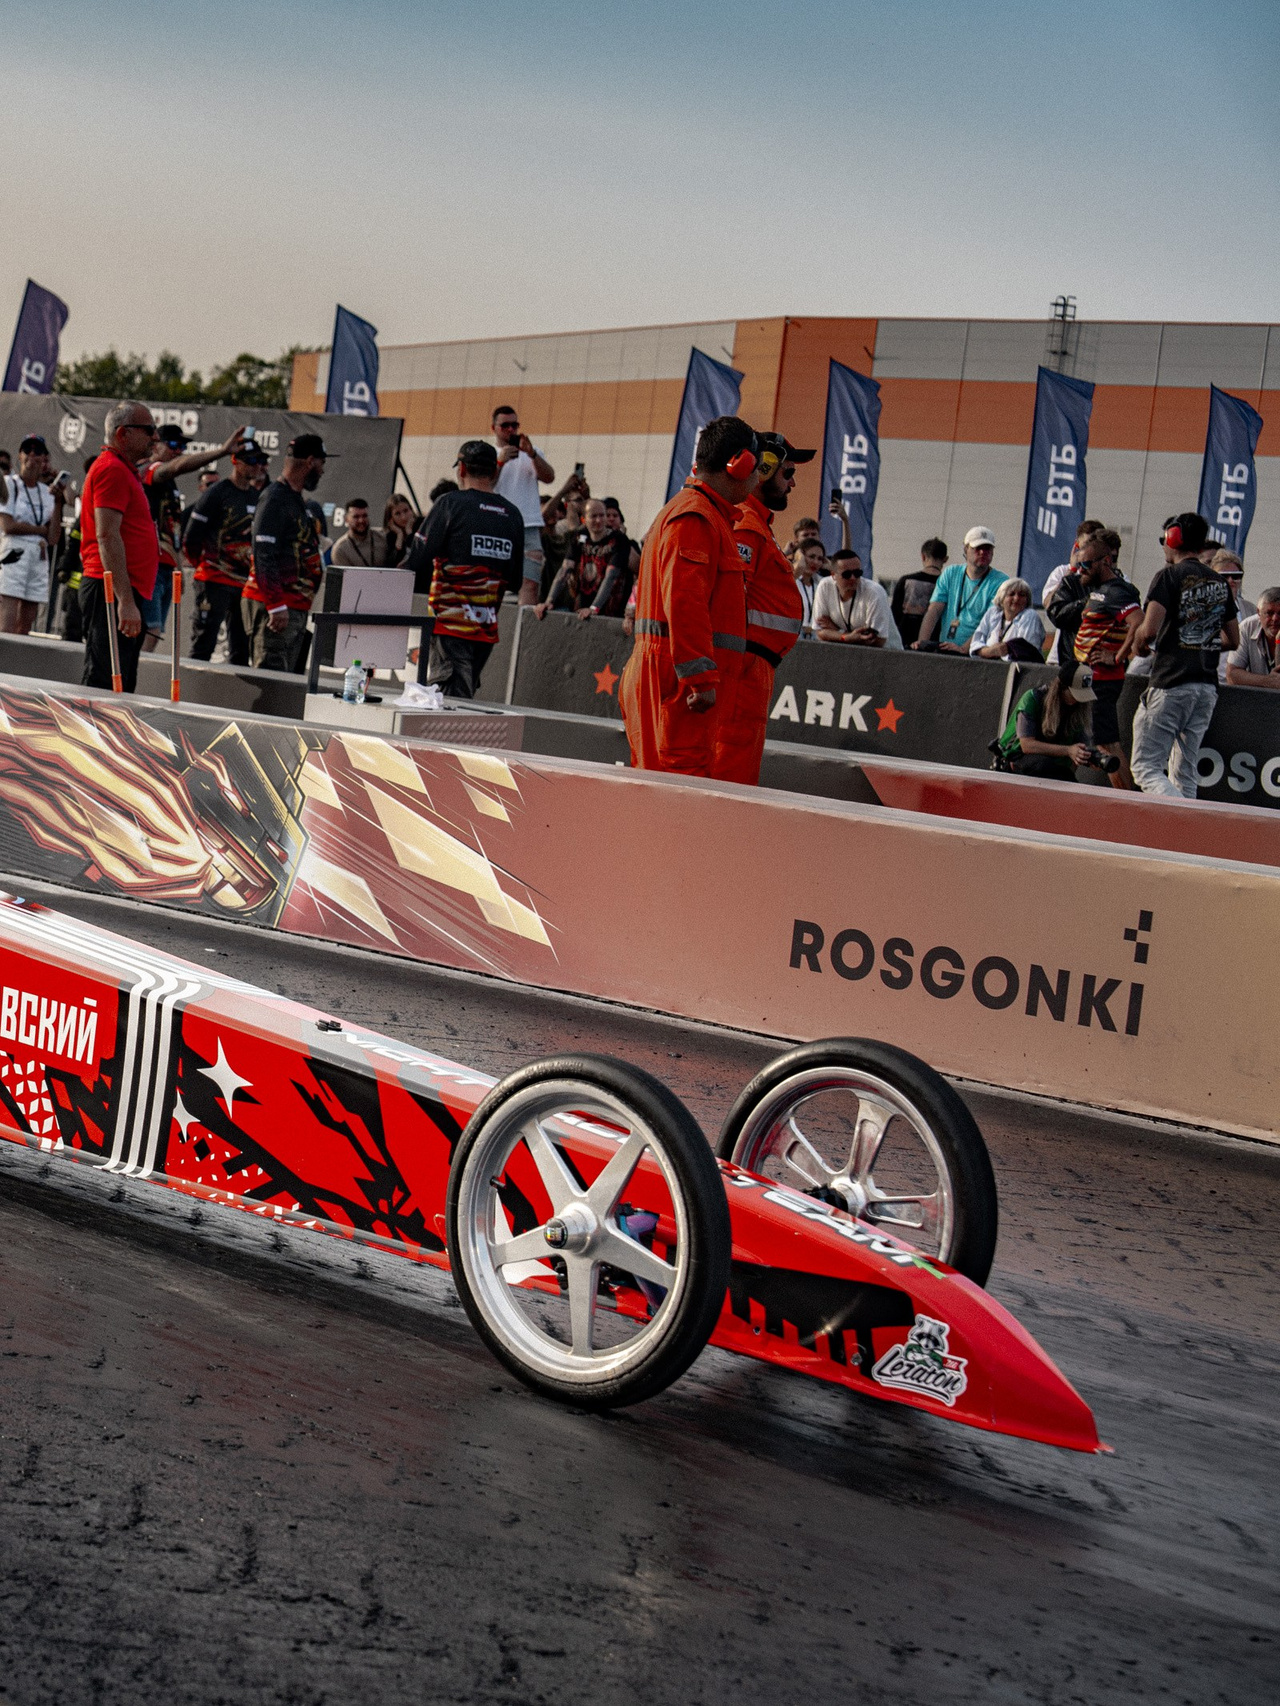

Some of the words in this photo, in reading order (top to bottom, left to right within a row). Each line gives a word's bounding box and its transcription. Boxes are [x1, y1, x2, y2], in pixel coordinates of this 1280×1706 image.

[343, 381, 370, 417] ТБ
[840, 433, 868, 494] ВТБ
[1046, 443, 1077, 507] ВТБ
[1217, 462, 1249, 527] ВТБ
[473, 536, 511, 553] RDRC
[770, 685, 873, 732] ARK
[789, 918, 1145, 1037] ROSGONKI
